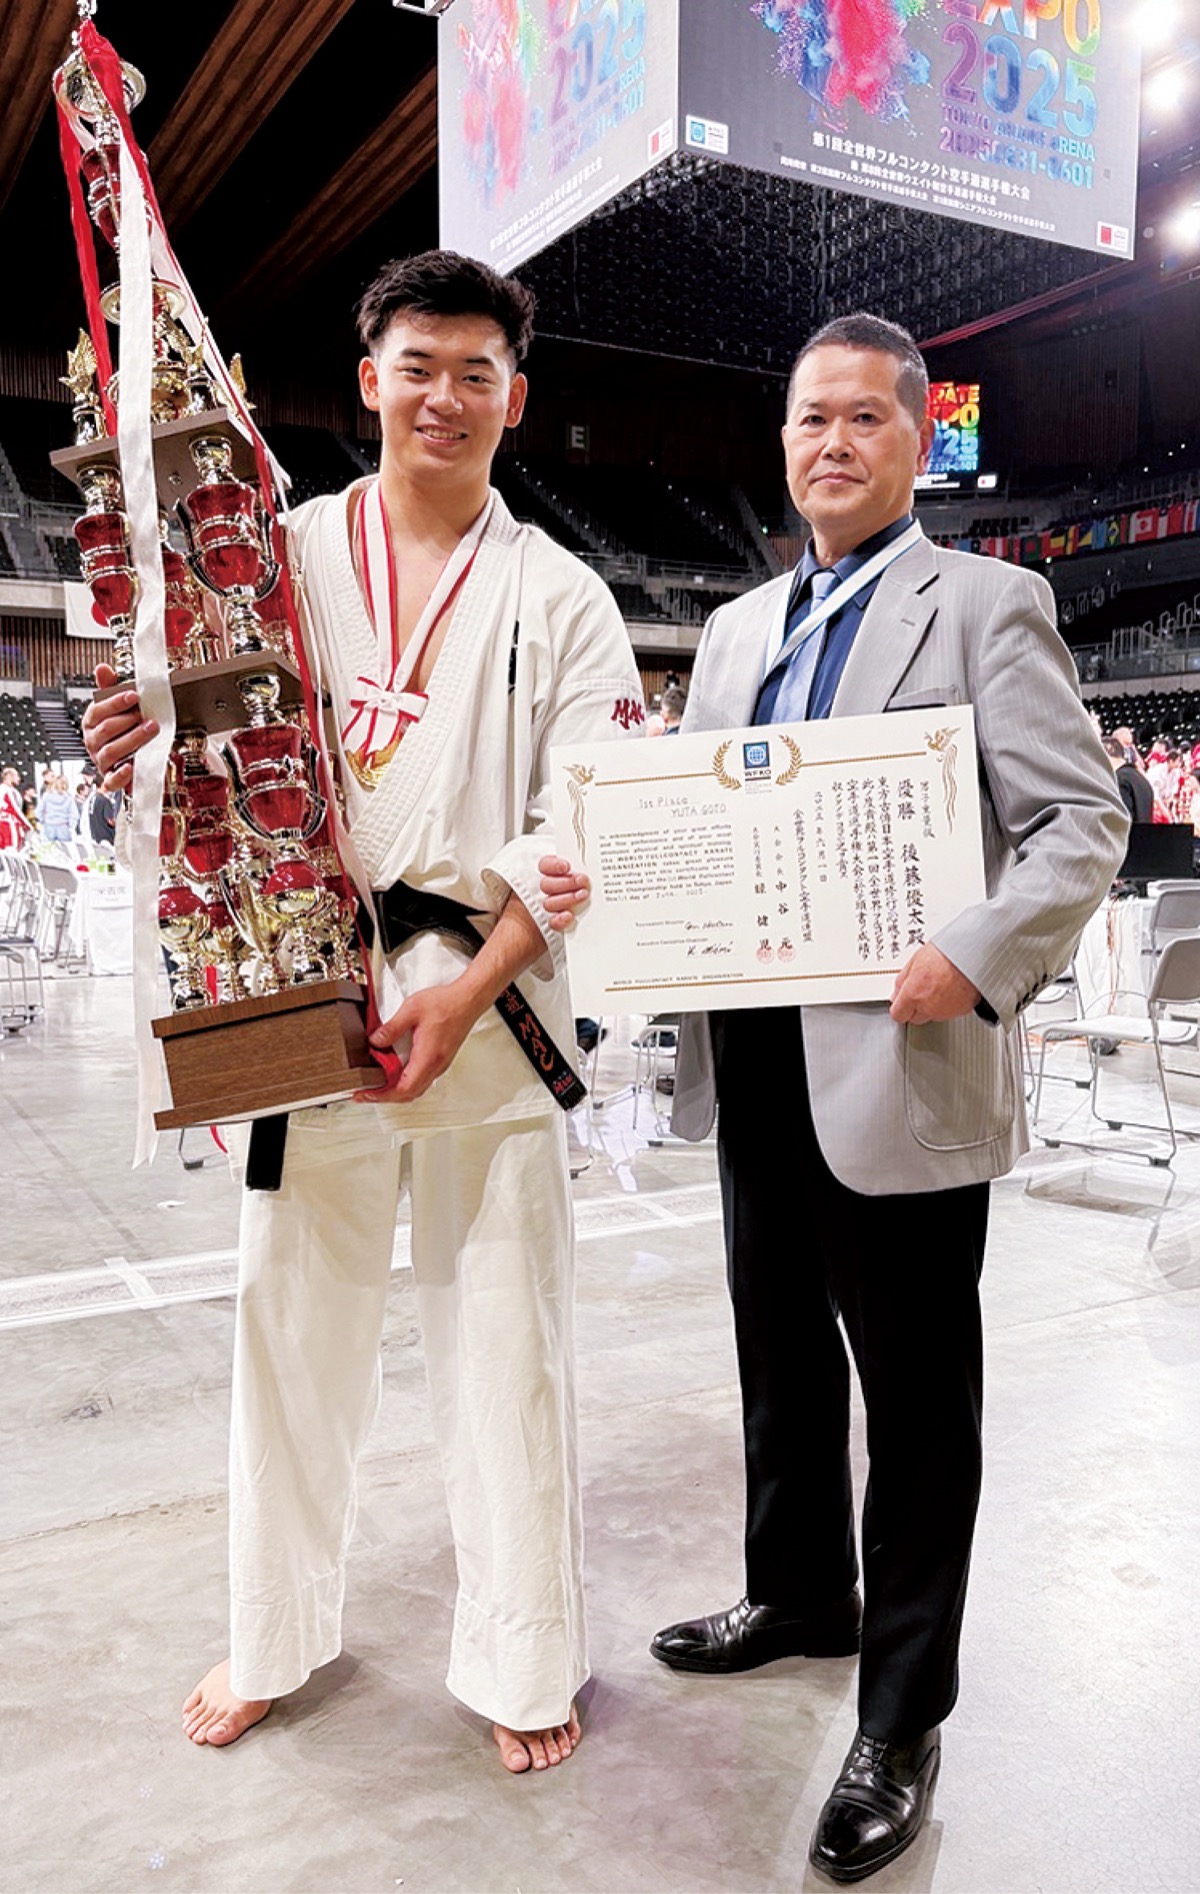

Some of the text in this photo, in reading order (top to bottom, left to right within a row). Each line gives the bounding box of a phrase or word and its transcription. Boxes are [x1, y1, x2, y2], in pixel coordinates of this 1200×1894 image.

[942, 23, 1098, 137] 2025
[929, 383, 980, 404] RATE
[571, 425, 585, 448] E
[671, 806, 698, 818] YUTA
